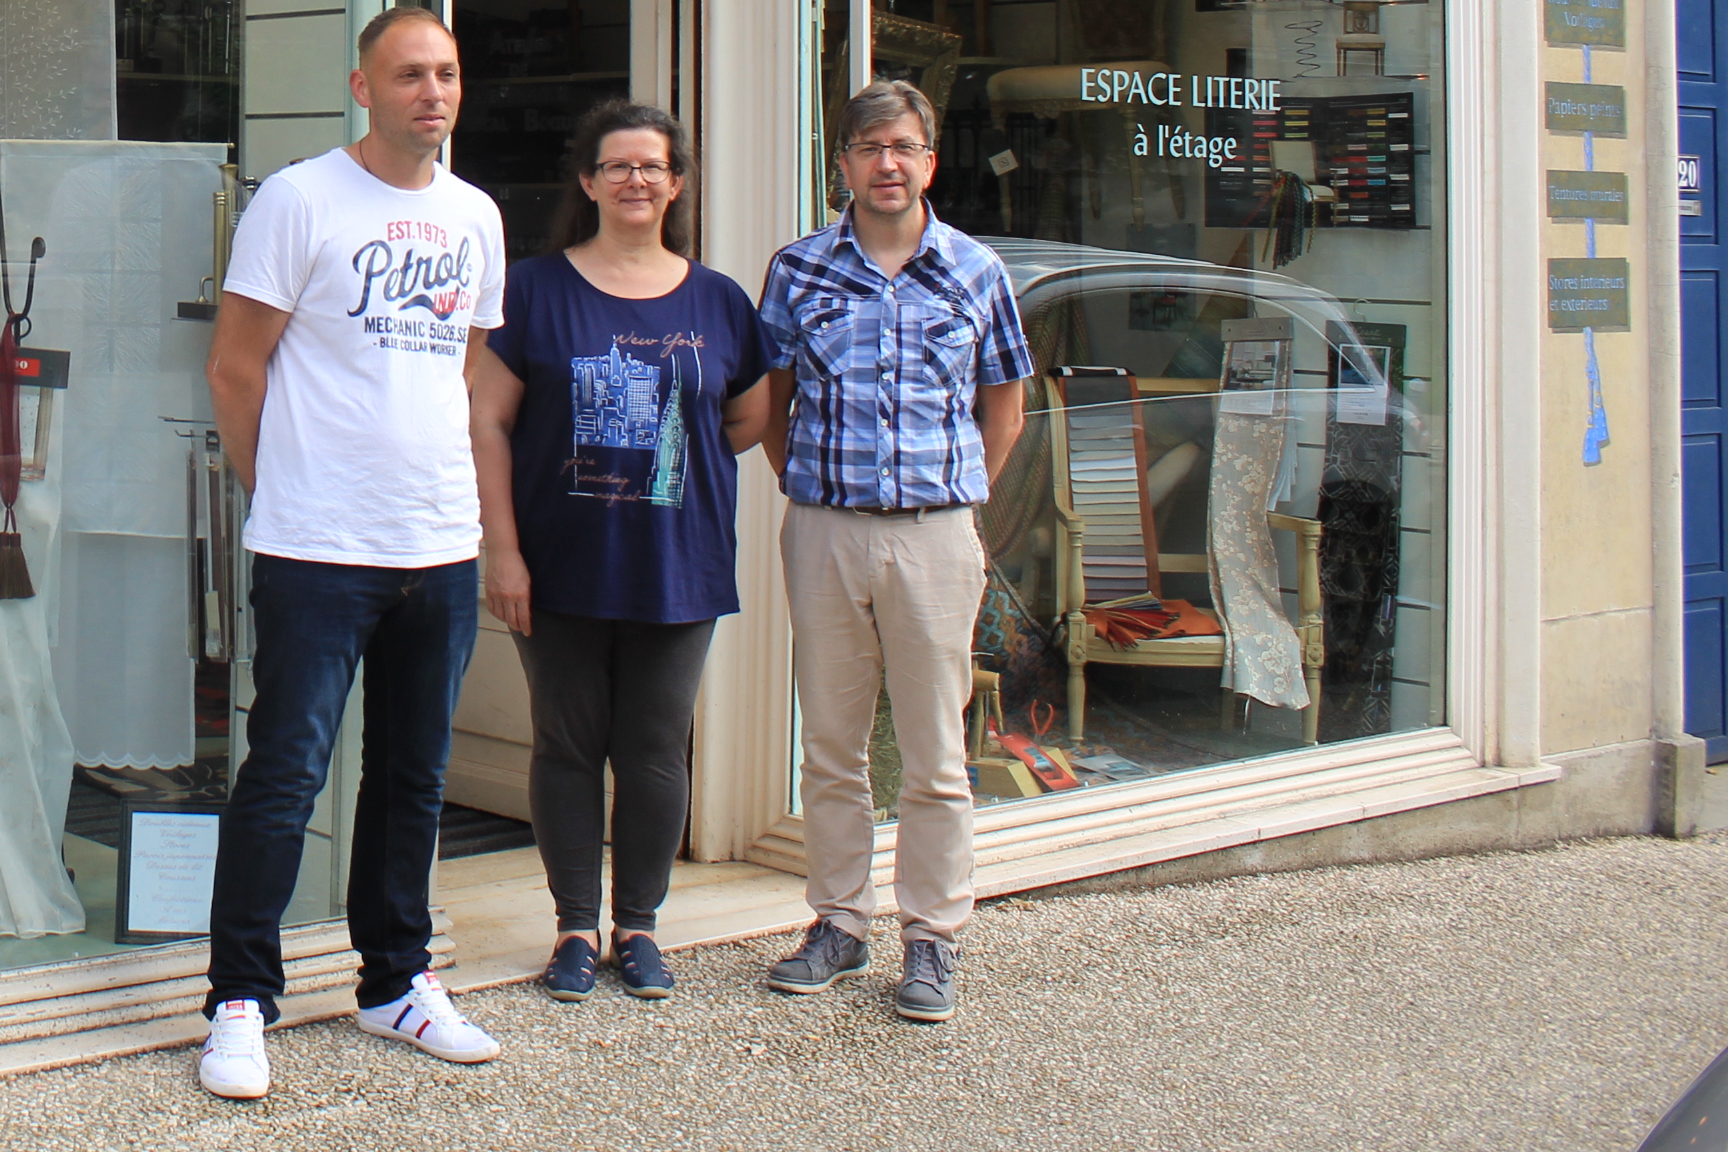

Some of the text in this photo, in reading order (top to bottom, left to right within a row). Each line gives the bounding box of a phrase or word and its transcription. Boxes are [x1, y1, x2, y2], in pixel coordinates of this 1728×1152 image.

[1080, 68, 1282, 112] ESPACE LITERIE
[1548, 97, 1587, 118] Papiers
[1133, 123, 1238, 168] à l'étage
[1678, 160, 1697, 187] 20
[387, 220, 448, 248] EST.1973
[347, 236, 470, 317] Petrol
[1549, 274, 1578, 290] Stores
[1550, 299, 1559, 311] et
[364, 317, 426, 338] MECHANIC
[615, 330, 705, 358] New York
